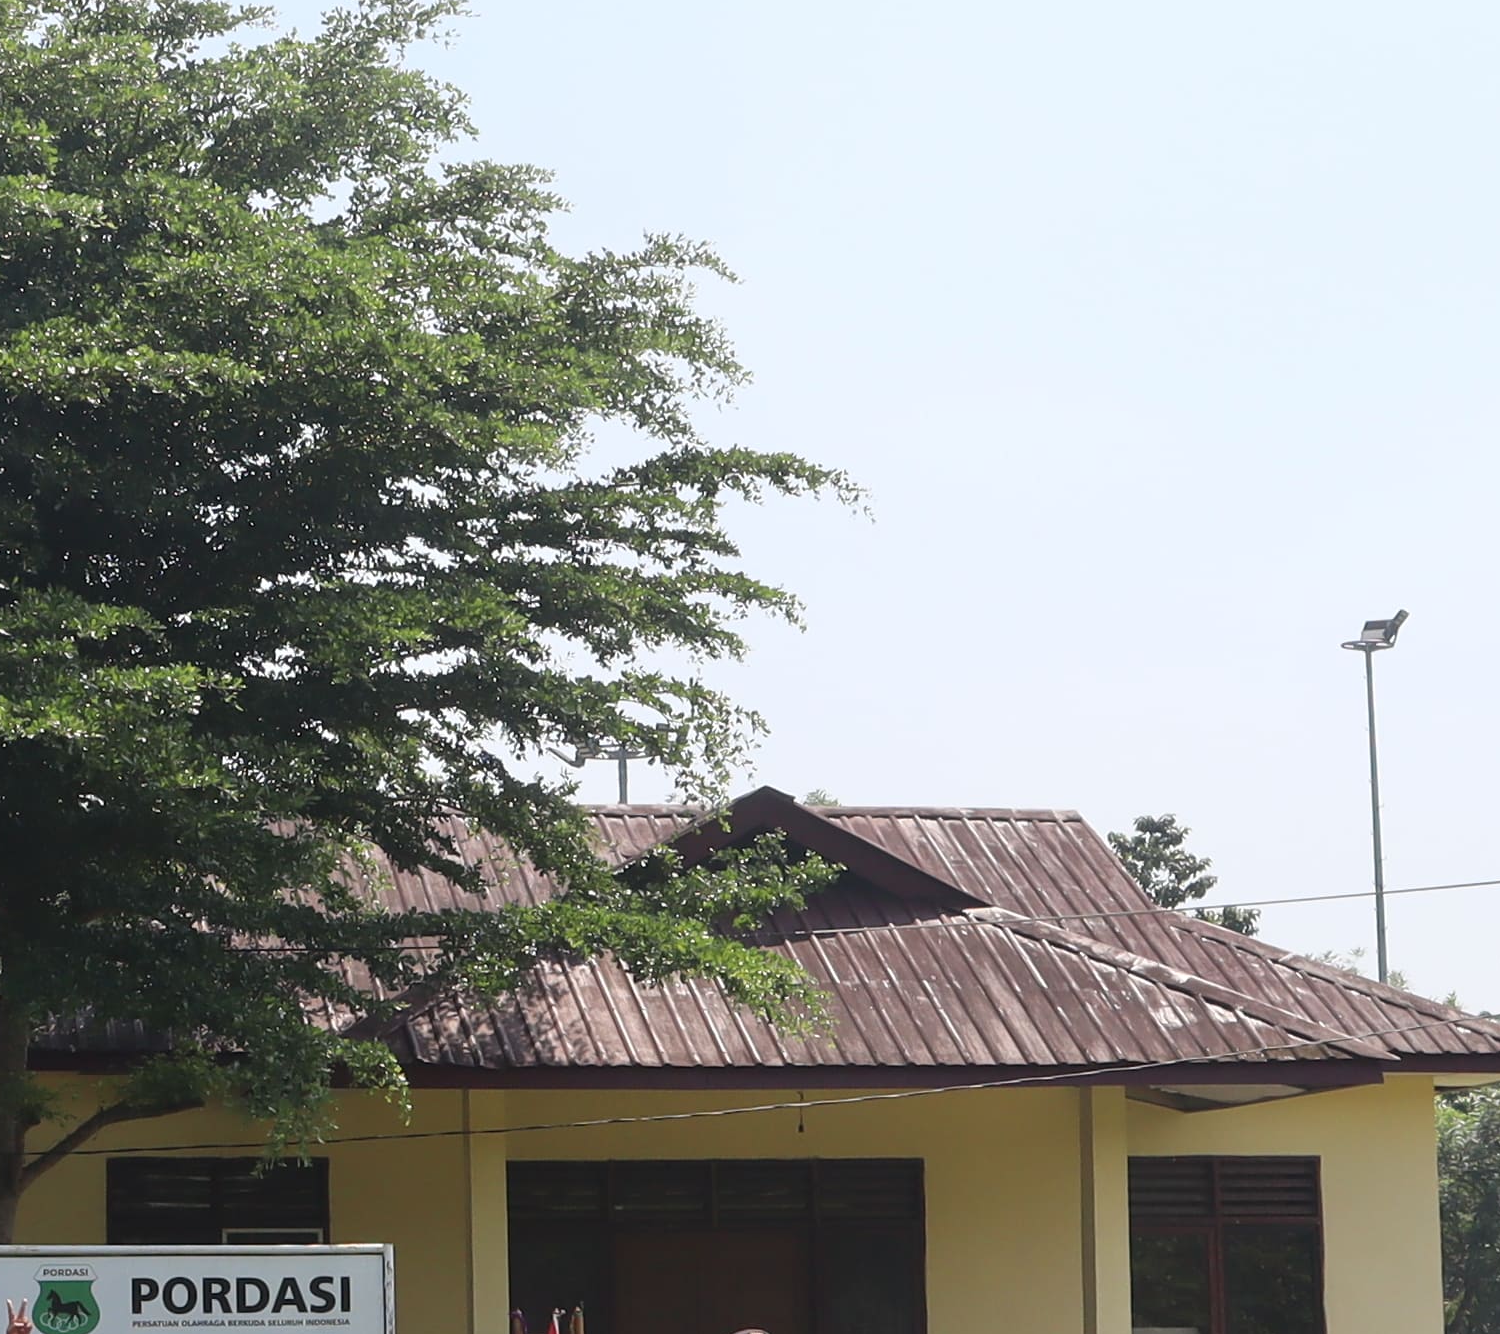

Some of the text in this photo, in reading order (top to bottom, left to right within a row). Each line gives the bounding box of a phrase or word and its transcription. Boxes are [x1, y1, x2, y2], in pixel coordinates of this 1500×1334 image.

[131, 1276, 351, 1314] PORDASI
[132, 1320, 179, 1328] PERSATUAN
[181, 1319, 226, 1327] OLAHRAGA
[228, 1319, 265, 1327] BERKUDA
[305, 1318, 350, 1326] INDONESIA
